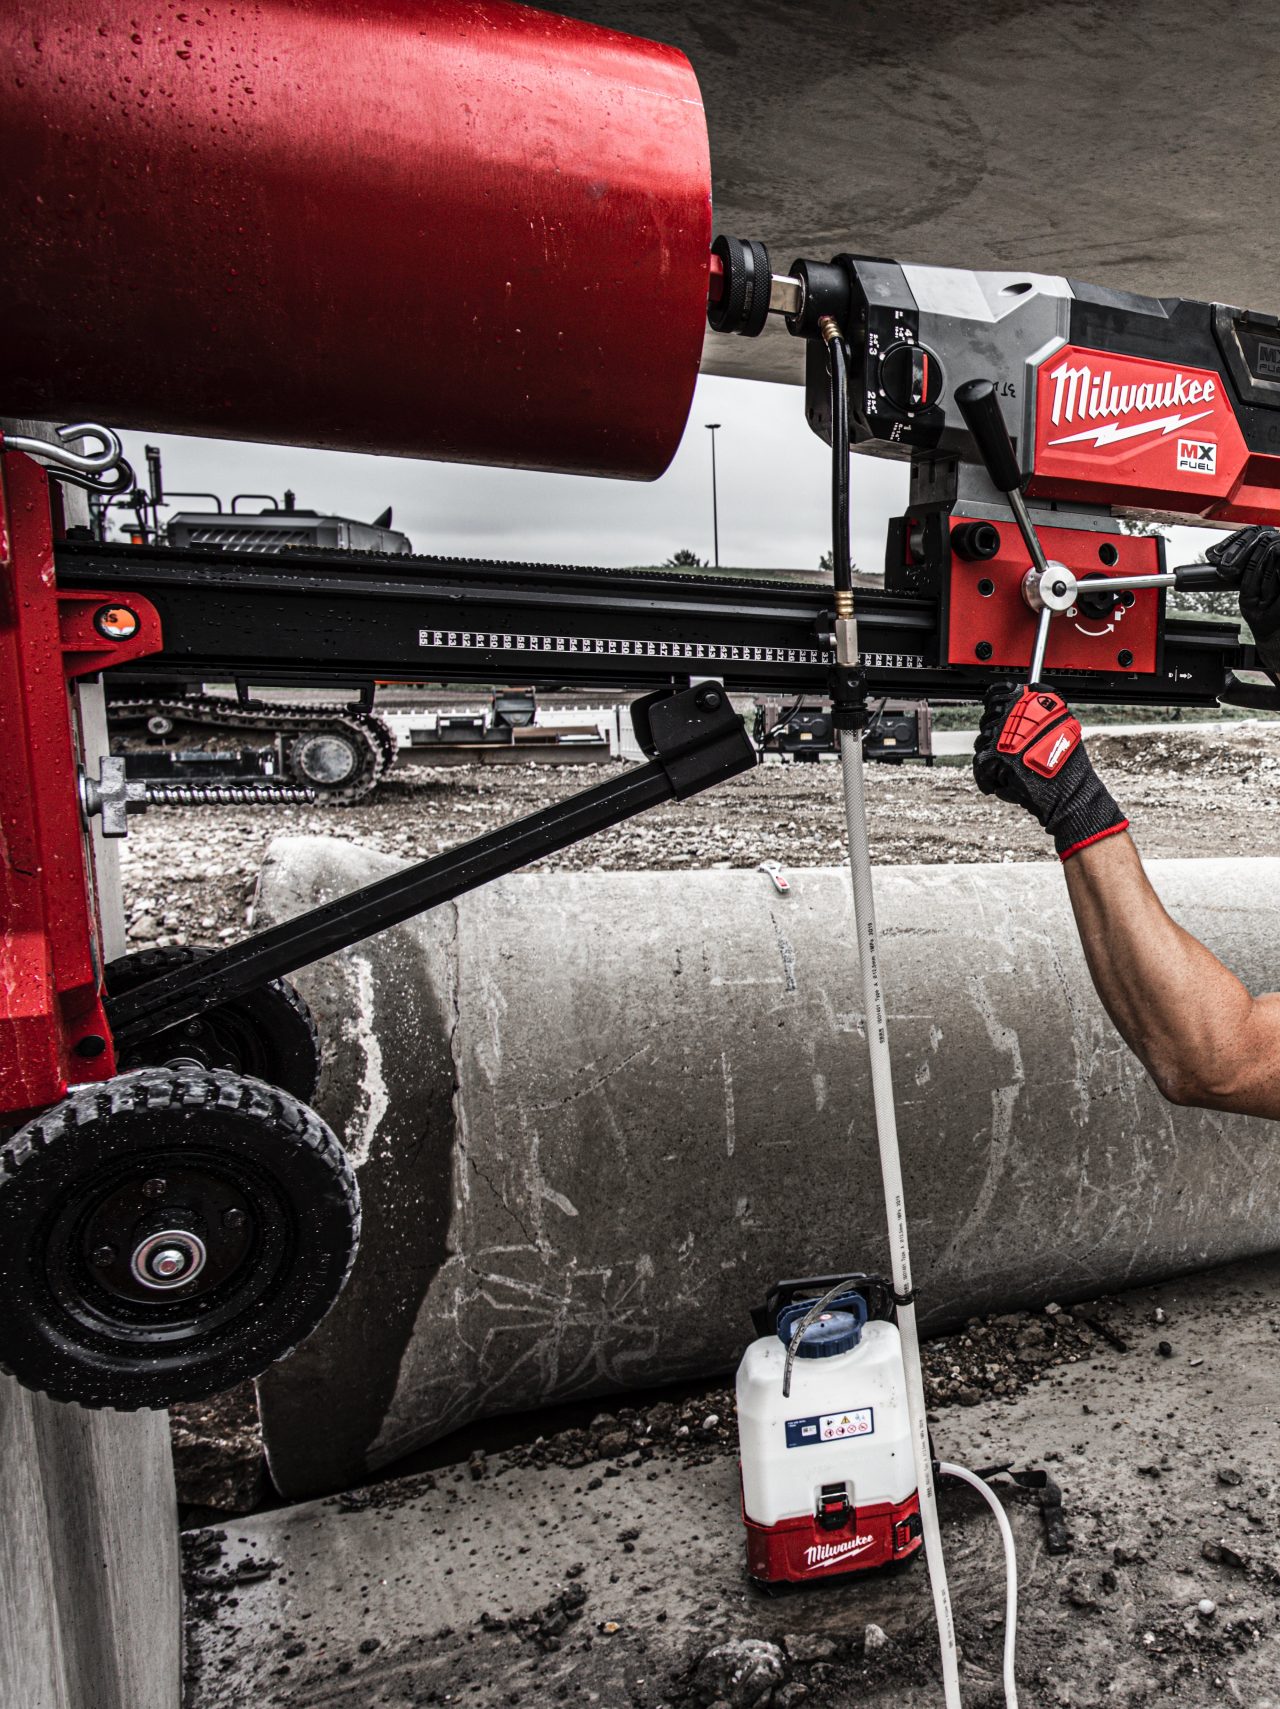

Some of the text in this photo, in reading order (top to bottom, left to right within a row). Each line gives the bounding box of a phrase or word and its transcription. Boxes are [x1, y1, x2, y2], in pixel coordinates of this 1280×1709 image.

[1050, 362, 1215, 427] Milwaukee
[1180, 442, 1215, 462] MX
[1179, 460, 1214, 472] FUEL
[803, 1534, 874, 1566] Milwaukee
